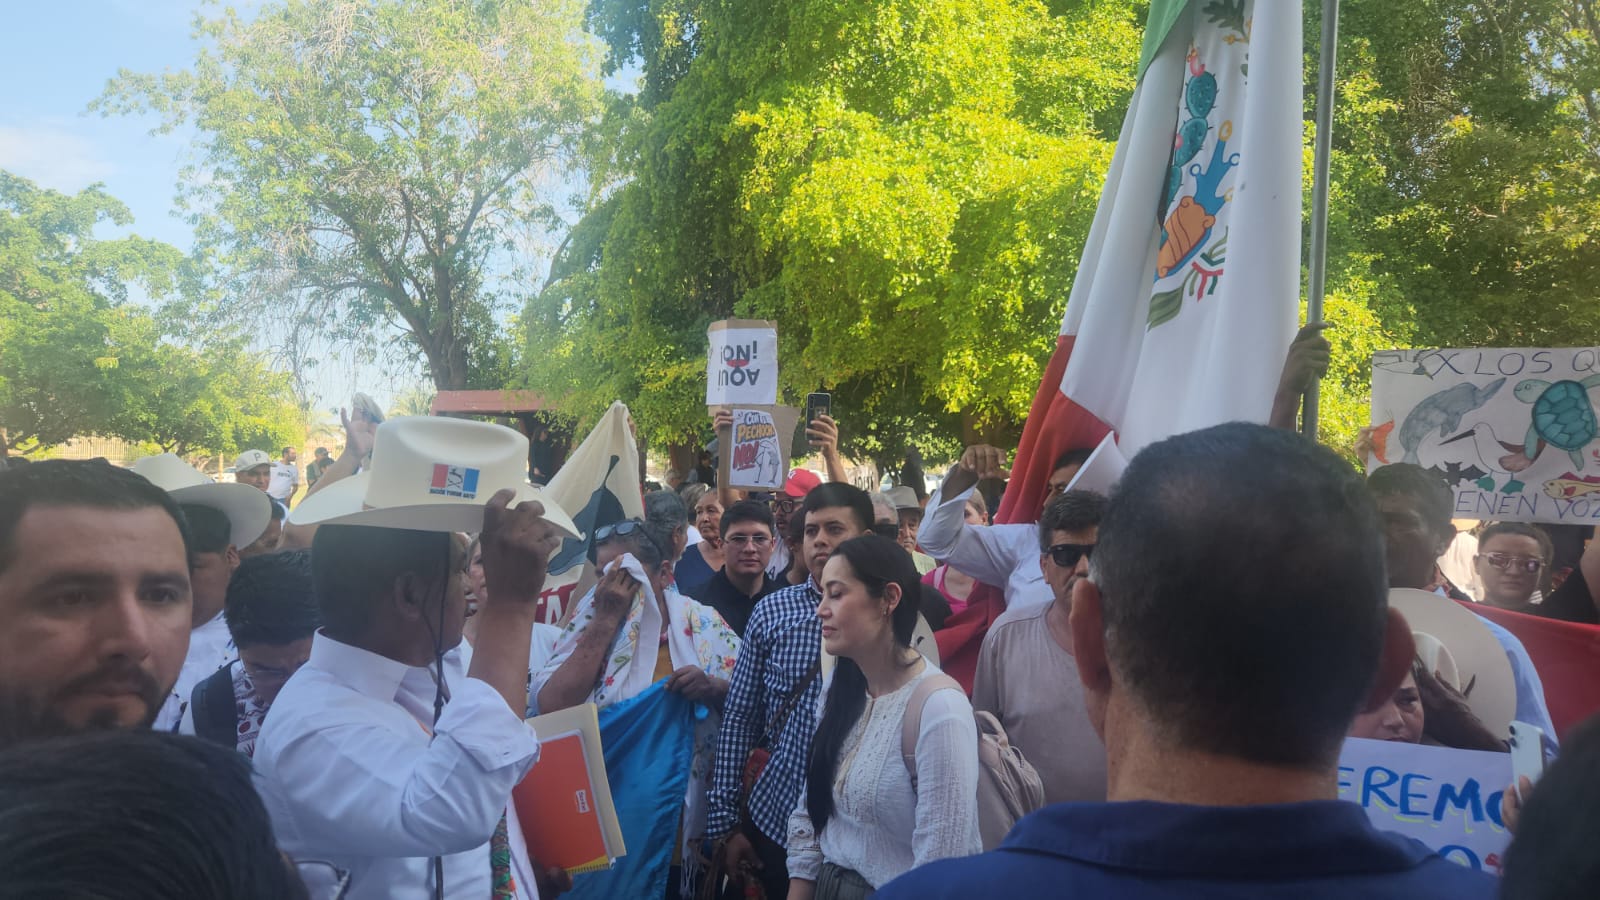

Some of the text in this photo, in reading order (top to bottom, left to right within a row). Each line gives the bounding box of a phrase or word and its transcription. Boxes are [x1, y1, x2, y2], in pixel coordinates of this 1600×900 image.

[1474, 351, 1553, 376] LOS
[1572, 349, 1600, 373] Q
[1455, 490, 1538, 516] ENEN
